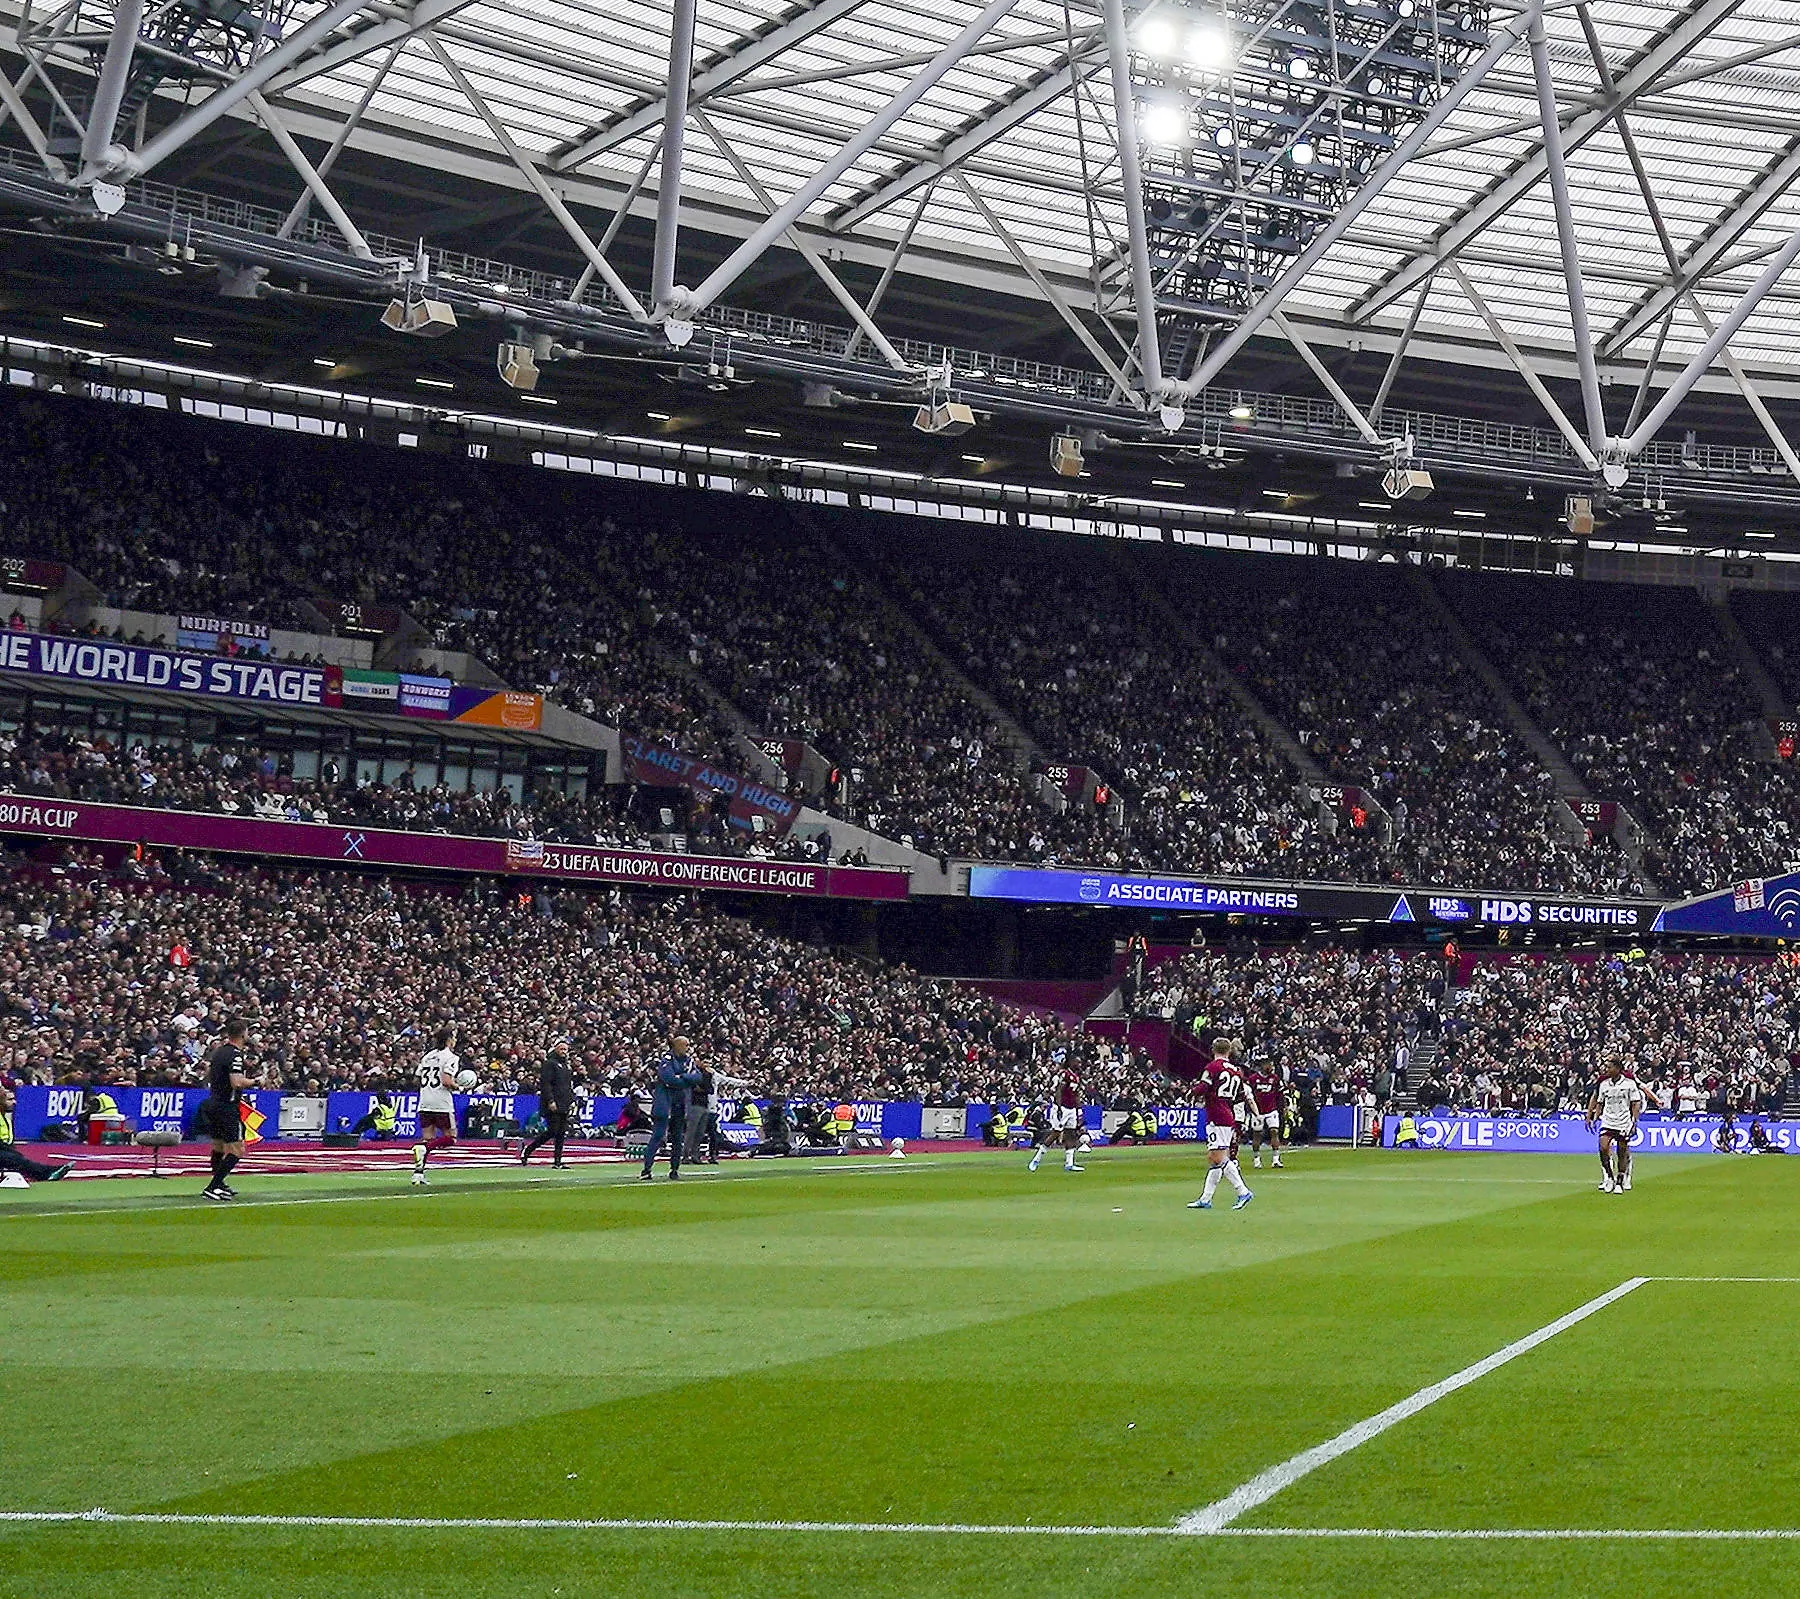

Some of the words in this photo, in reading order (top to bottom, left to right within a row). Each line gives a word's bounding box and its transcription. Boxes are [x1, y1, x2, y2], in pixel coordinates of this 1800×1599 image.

[2, 558, 25, 571] 202
[341, 604, 362, 617] 201
[179, 614, 268, 638] NORFOLK
[40, 639, 202, 690] WORLD'S
[209, 662, 324, 703] STAGE
[1779, 720, 1798, 732] 252
[761, 741, 784, 754] 256
[1048, 766, 1069, 778] 255
[696, 768, 739, 794] AND
[740, 784, 794, 817] HUGH
[1322, 788, 1344, 799] 254
[21, 806, 41, 826] FA
[44, 808, 78, 829] CUP
[1580, 803, 1600, 814] 253
[563, 854, 600, 872] UEFA
[602, 857, 659, 877] EUROPA
[661, 861, 757, 884] CONFERENCE
[760, 869, 815, 888] LEAGUE
[1107, 883, 1204, 904] ASSOCIATE
[1206, 887, 1298, 909] PARTNERS
[1429, 897, 1459, 911] HDS
[1480, 900, 1532, 923] HDS
[1538, 905, 1638, 925] SECURITIES
[420, 1066, 441, 1089] 33
[1217, 1071, 1241, 1101] 20
[47, 1090, 87, 1117] BOYL
[140, 1091, 184, 1118] BOYLE
[857, 1102, 883, 1123] OYLE
[1158, 1109, 1198, 1126] BOYLE
[1422, 1121, 1493, 1146] OYLE
[1497, 1122, 1559, 1139] SPORTS
[1647, 1128, 1706, 1148] TWO
